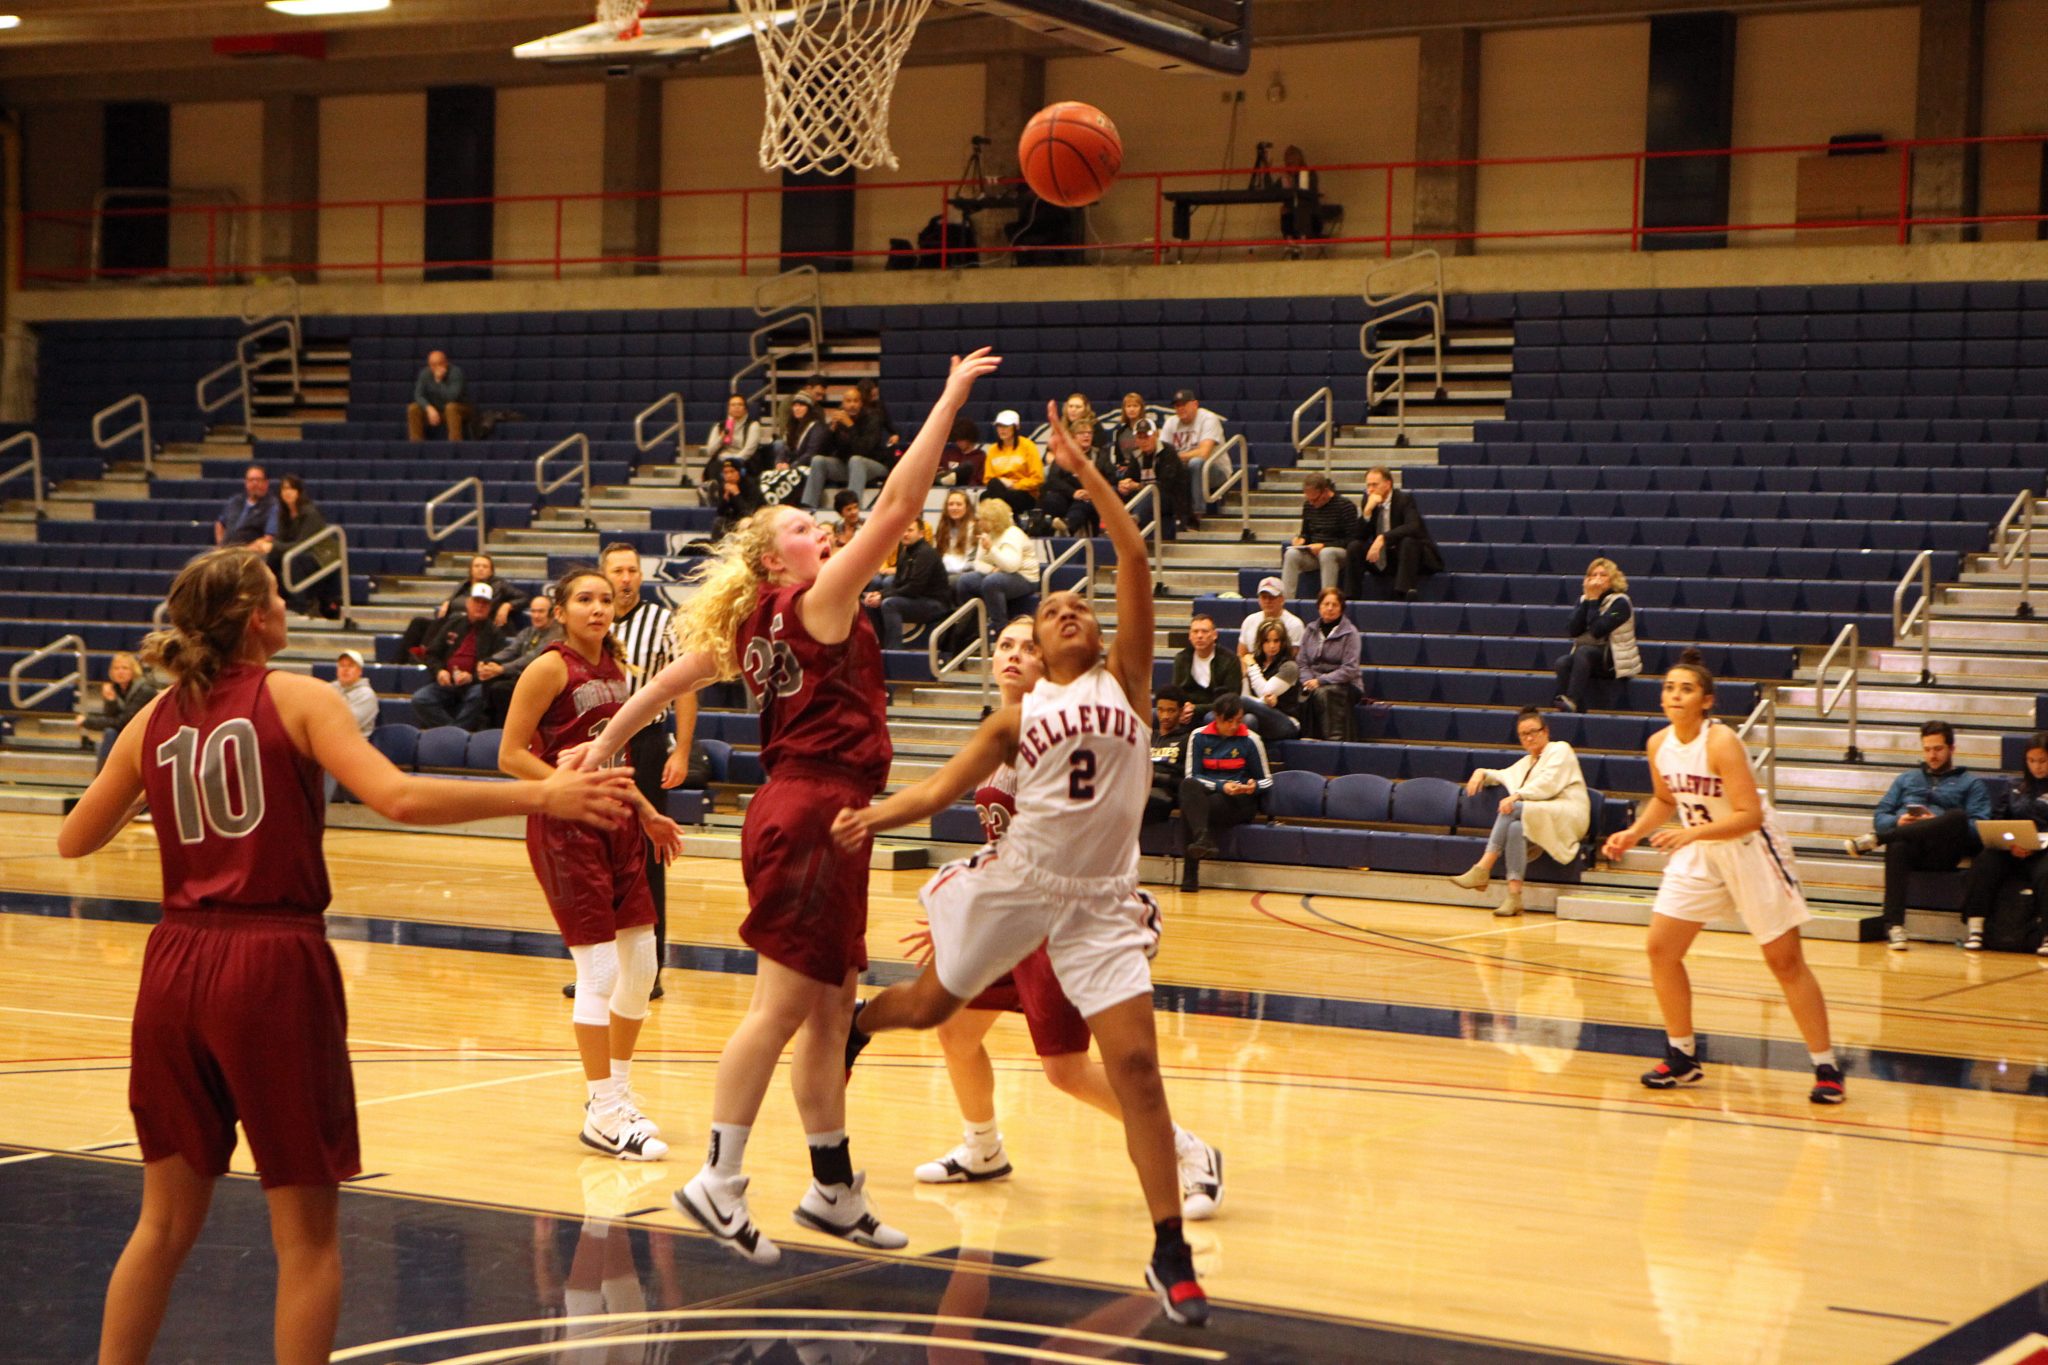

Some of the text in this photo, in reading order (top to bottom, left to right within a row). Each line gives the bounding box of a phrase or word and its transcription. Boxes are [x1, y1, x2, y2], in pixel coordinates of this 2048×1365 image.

[1019, 705, 1139, 769] BELLEVUE
[156, 717, 266, 845] 10
[1069, 748, 1097, 800] 2
